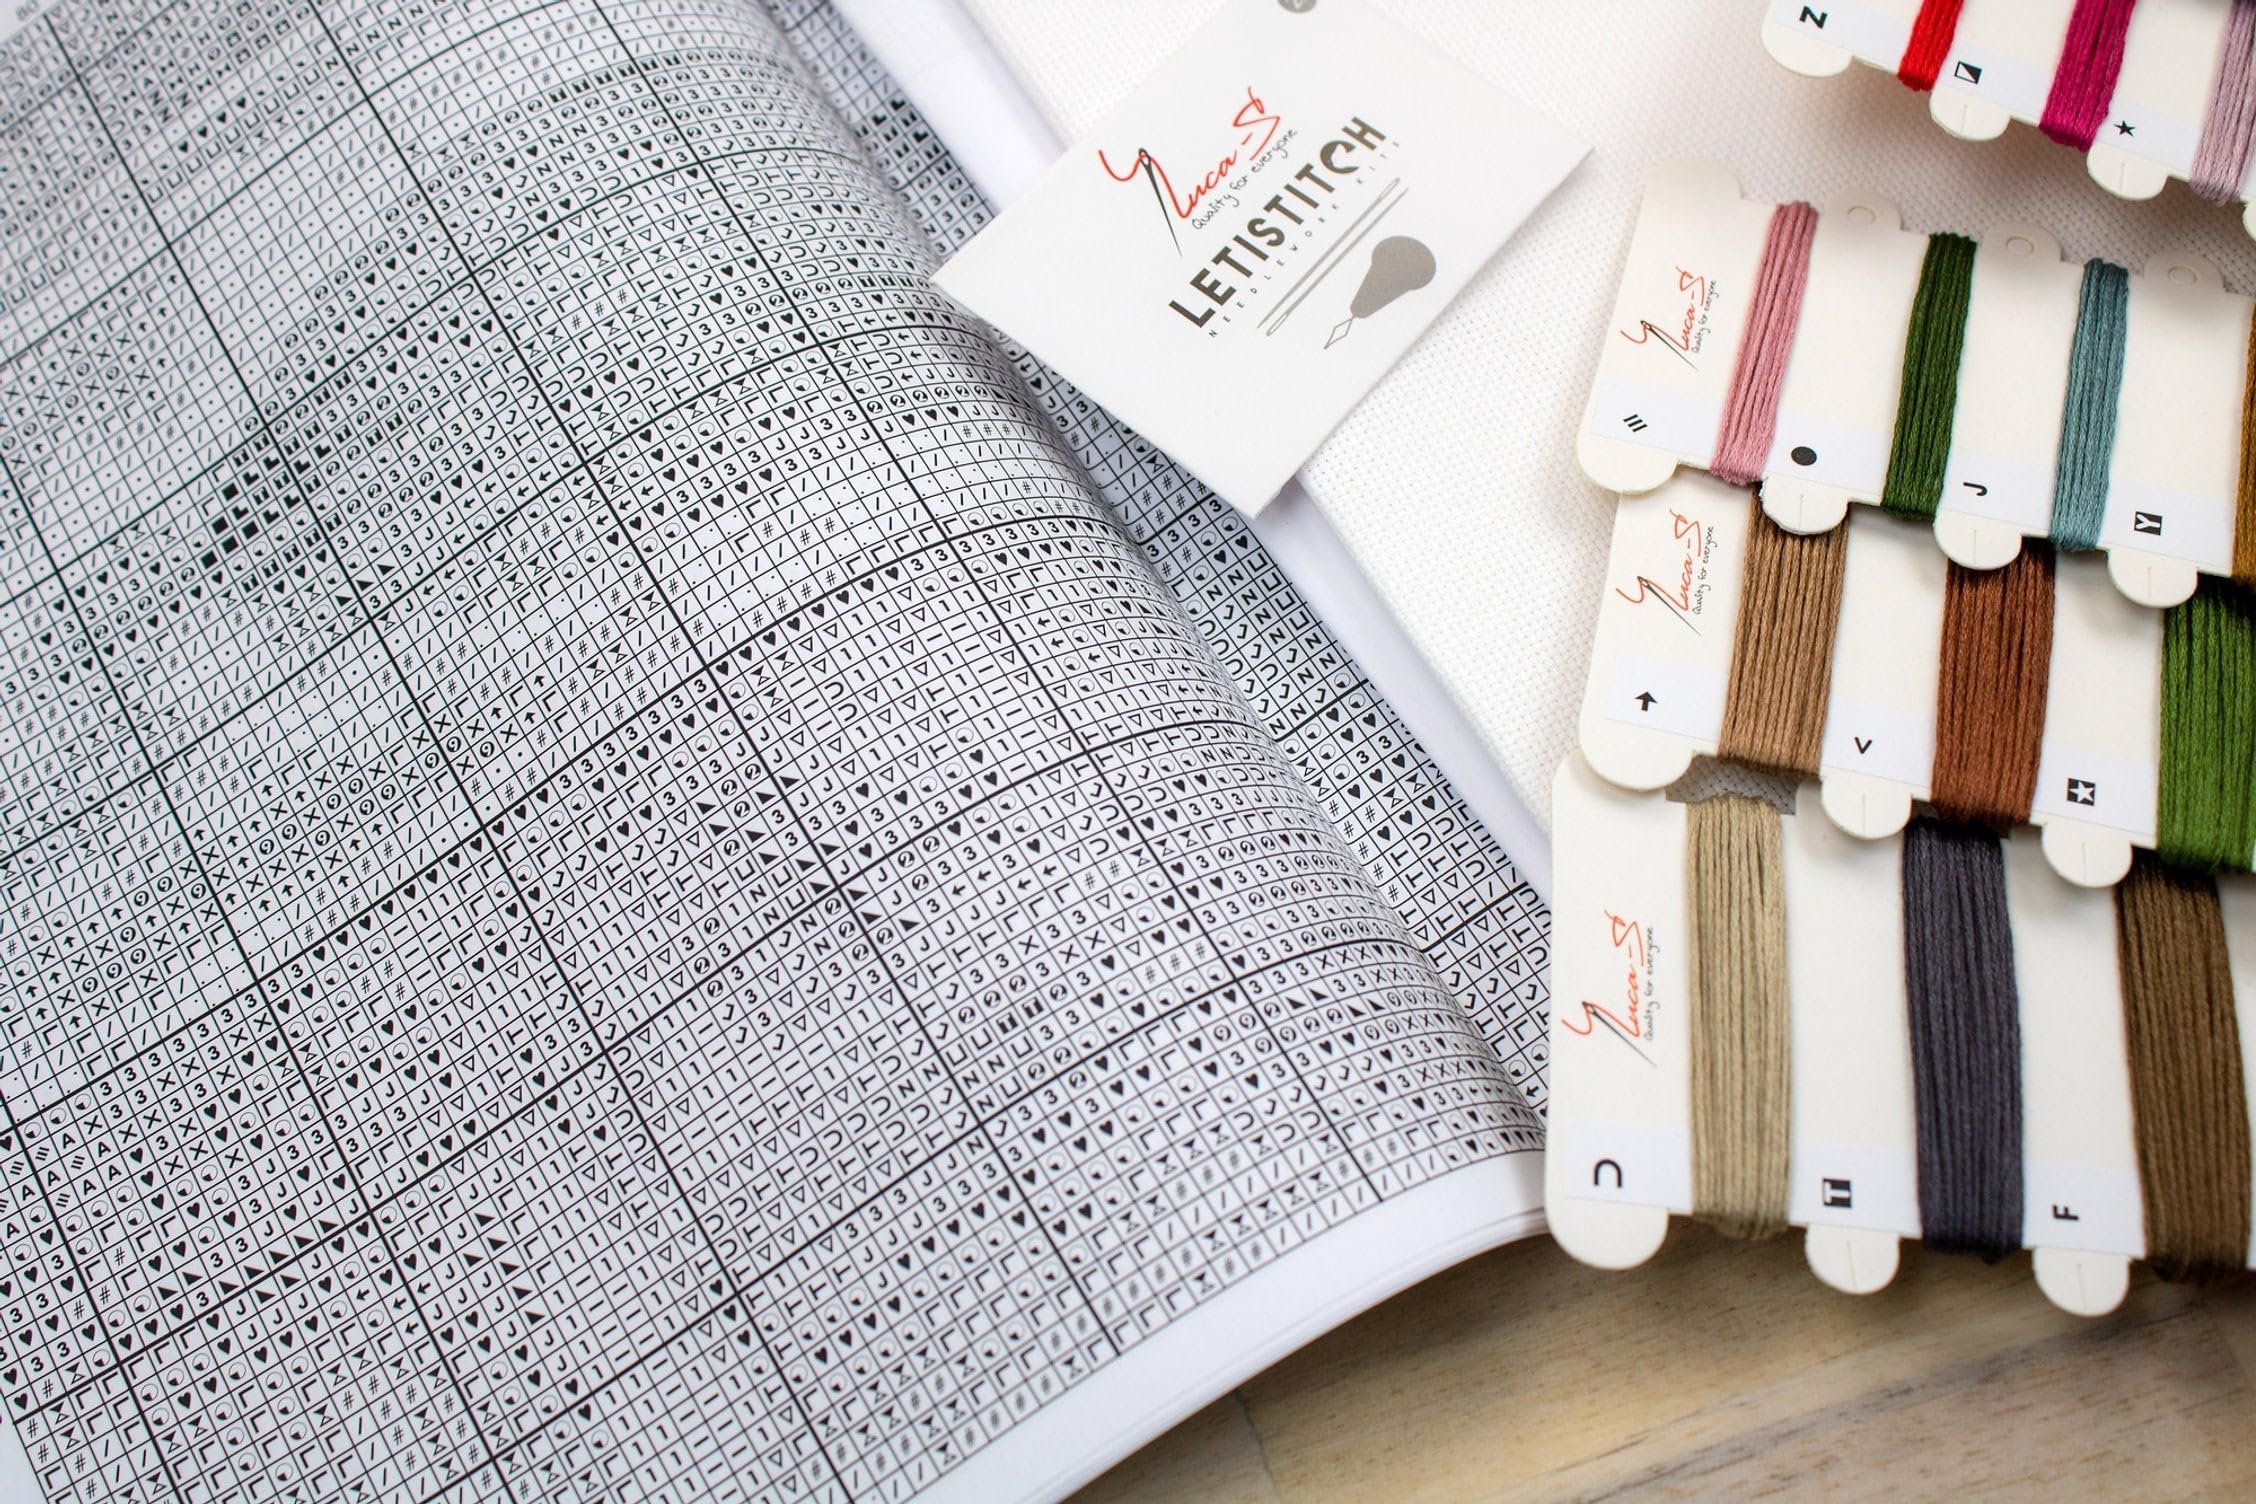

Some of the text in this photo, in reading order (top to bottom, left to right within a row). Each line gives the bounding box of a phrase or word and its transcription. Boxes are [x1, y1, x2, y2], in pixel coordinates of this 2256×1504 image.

[1168, 116, 1387, 328] LETISTITCH
[1191, 129, 1298, 230] Quality for everyone
[1207, 203, 1340, 338] NEEDLEWORK
[1691, 327, 1711, 354] Quality
[1704, 279, 1719, 312] everyone
[1692, 583, 1712, 615] Quality
[1702, 525, 1718, 564] everyone
[1646, 927, 1661, 975] everyone
